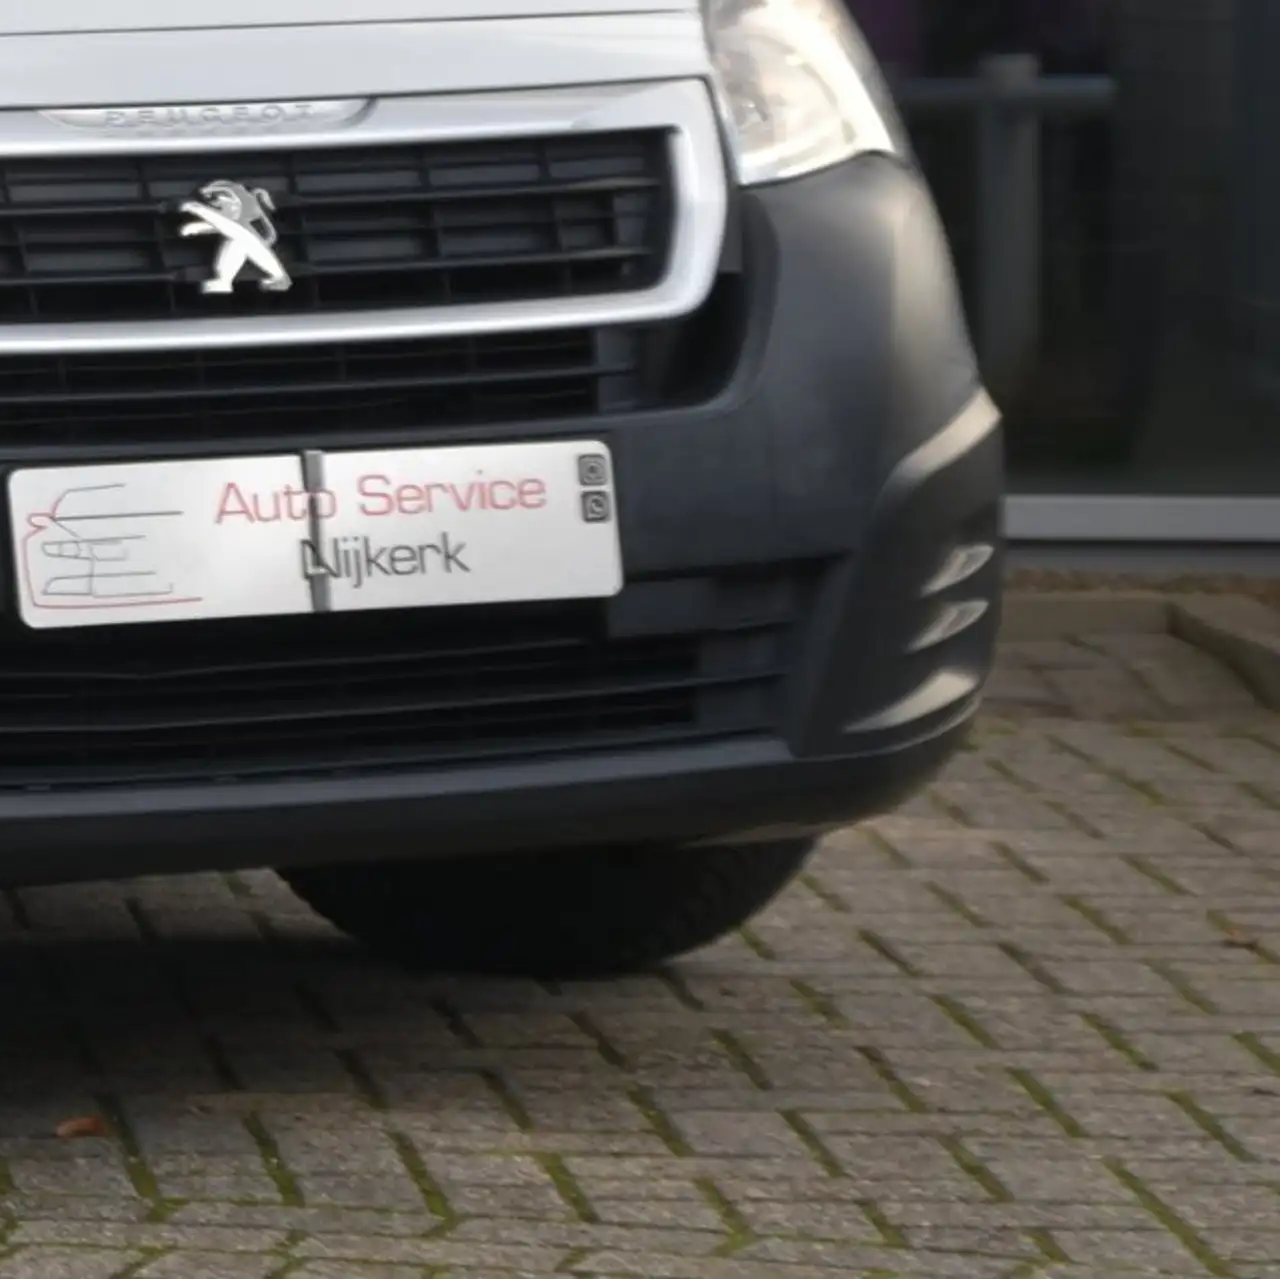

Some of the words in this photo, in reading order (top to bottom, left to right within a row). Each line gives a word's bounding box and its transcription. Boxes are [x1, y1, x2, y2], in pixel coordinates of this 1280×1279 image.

[215, 481, 337, 524] Auto
[357, 470, 547, 518] Service
[301, 532, 470, 588] Nijkerk
